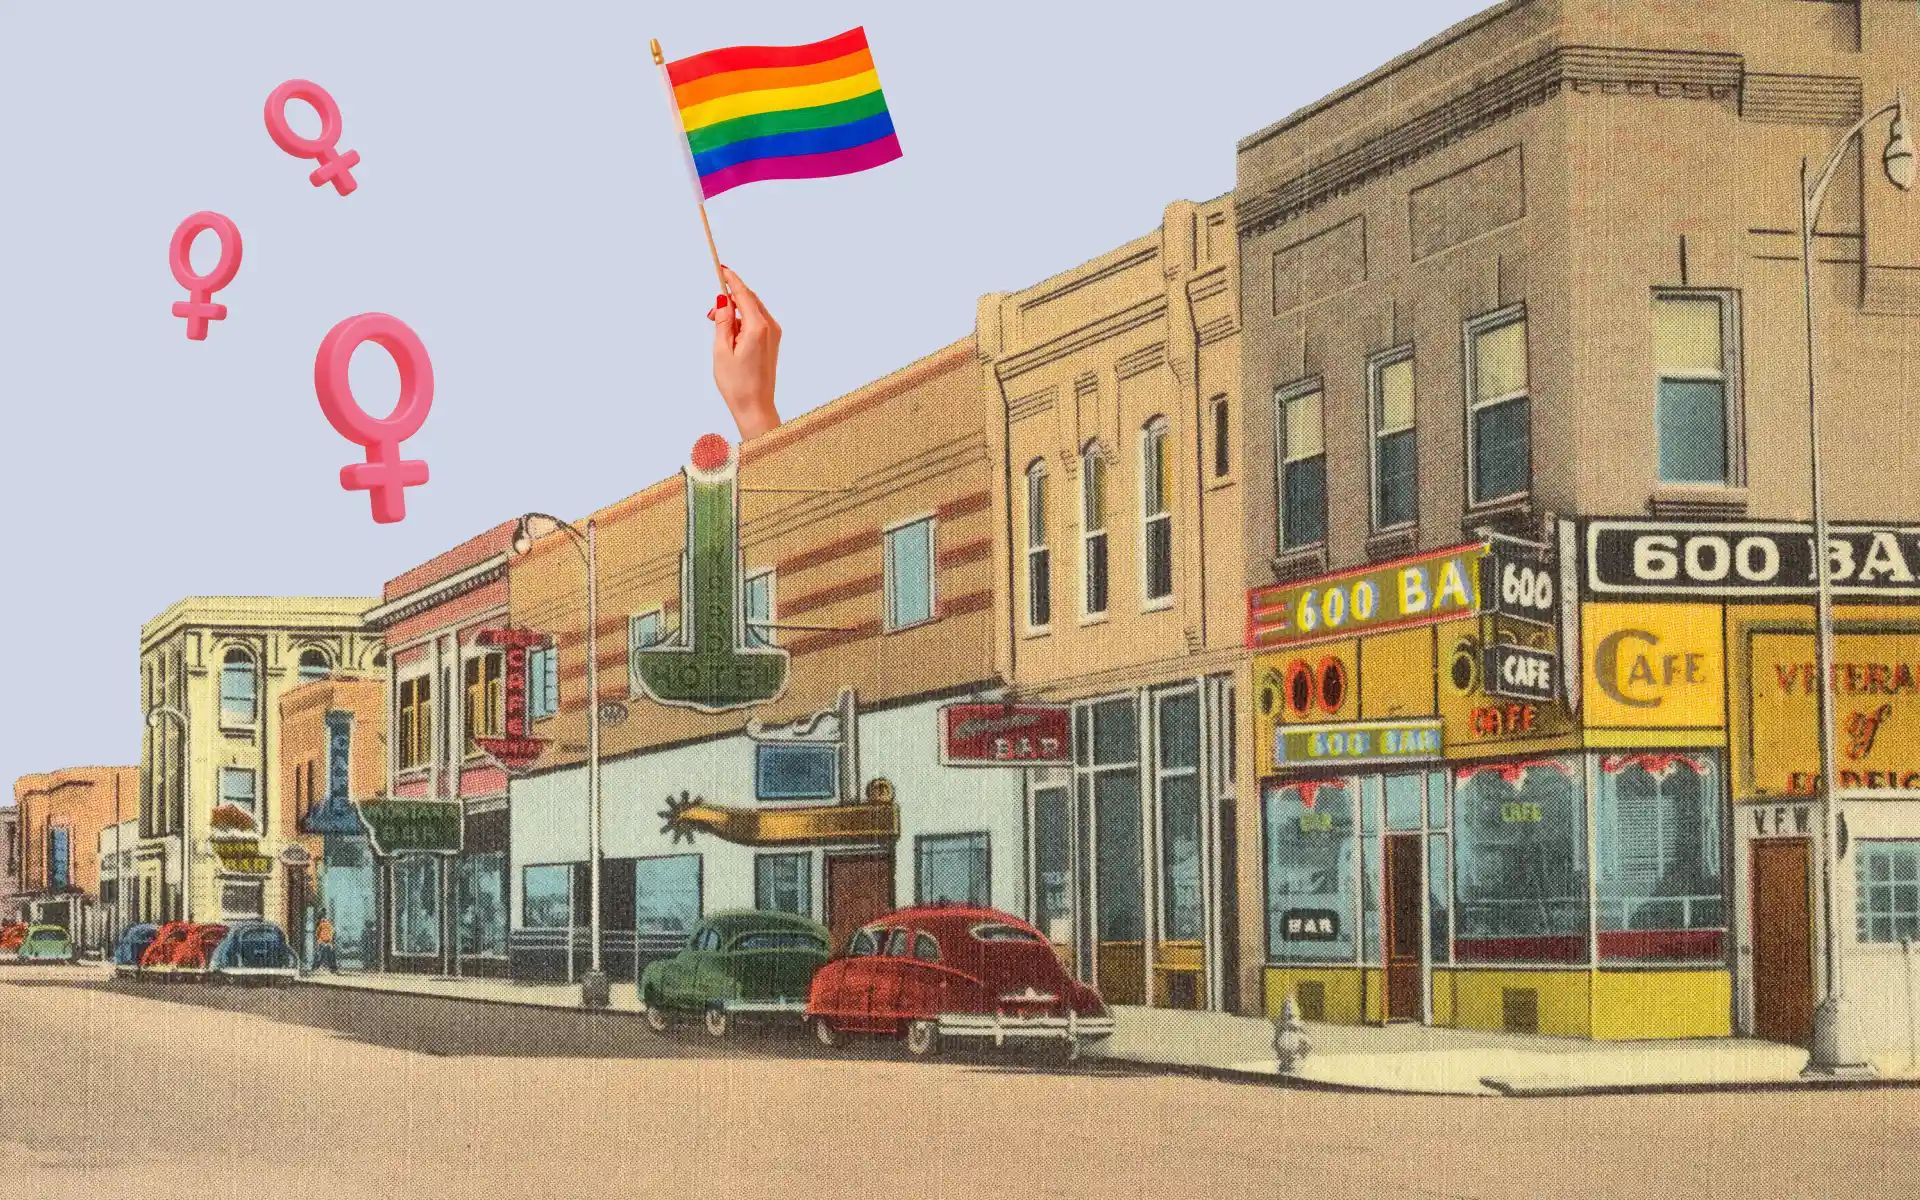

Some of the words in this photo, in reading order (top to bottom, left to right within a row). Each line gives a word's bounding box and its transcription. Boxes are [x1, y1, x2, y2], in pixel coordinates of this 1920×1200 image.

[1633, 535, 1780, 581] 600
[1807, 530, 1920, 582] BA
[1297, 579, 1378, 632] 600
[1398, 558, 1479, 616] BA
[1502, 562, 1553, 609] 600
[650, 663, 778, 692] HOTEL
[1503, 654, 1550, 689] CAFE
[1595, 628, 1707, 708] CAFE
[1775, 662, 1920, 696] VETERA
[1254, 655, 1347, 717] 600
[1469, 703, 1537, 737] CAFE
[1844, 703, 1893, 760] of
[995, 738, 1060, 760] BAR
[1307, 731, 1371, 757] 600
[1379, 729, 1442, 754] BAR
[1288, 918, 1333, 934] BAR
